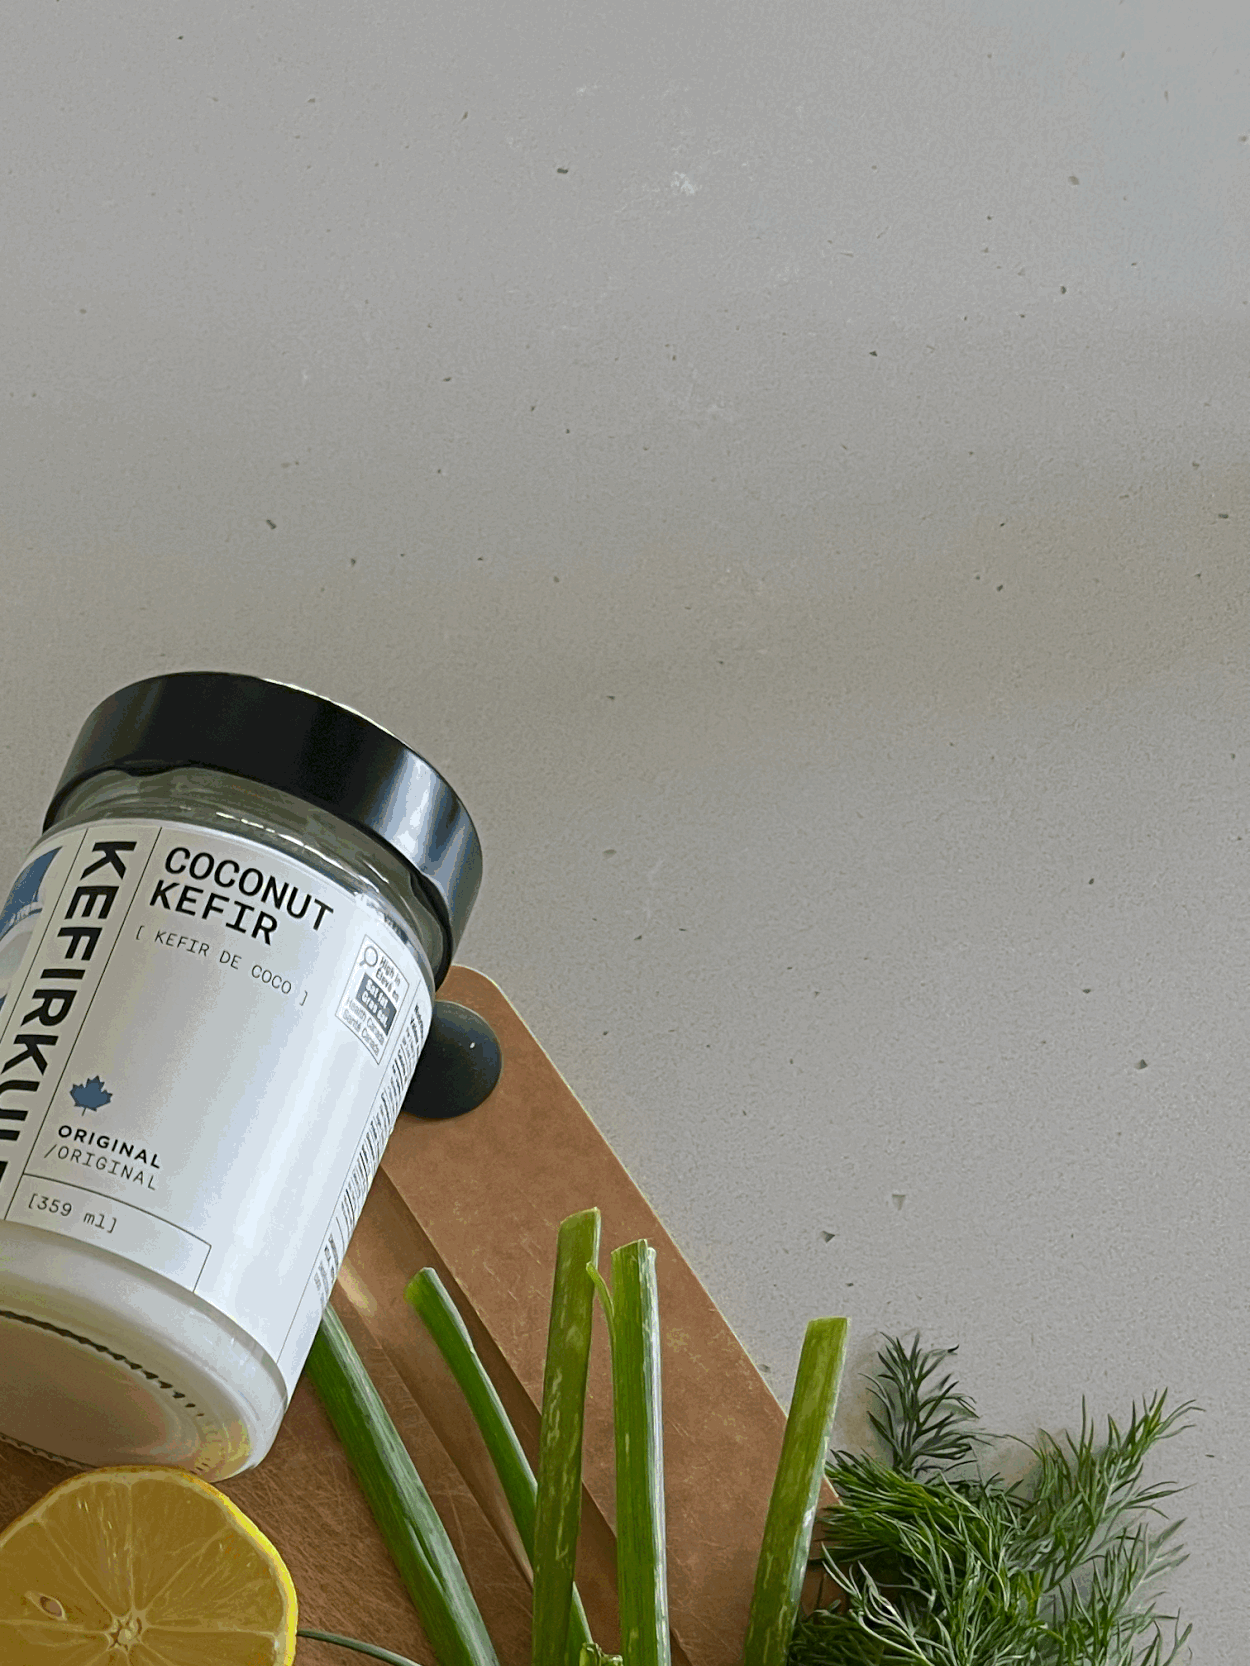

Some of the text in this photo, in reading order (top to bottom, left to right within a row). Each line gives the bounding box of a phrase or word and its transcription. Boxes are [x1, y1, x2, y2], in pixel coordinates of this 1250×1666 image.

[149, 879, 278, 946] KEFIR
[165, 847, 334, 931] COCONUT
[154, 930, 210, 957] KEFIR
[219, 950, 243, 970] DE
[251, 964, 292, 995] COCO
[379, 956, 395, 980] High
[44, 1144, 156, 1191] /ORIGINAL
[58, 1125, 161, 1169] ORIGINAL
[28, 1193, 117, 1234] [359 ml]
